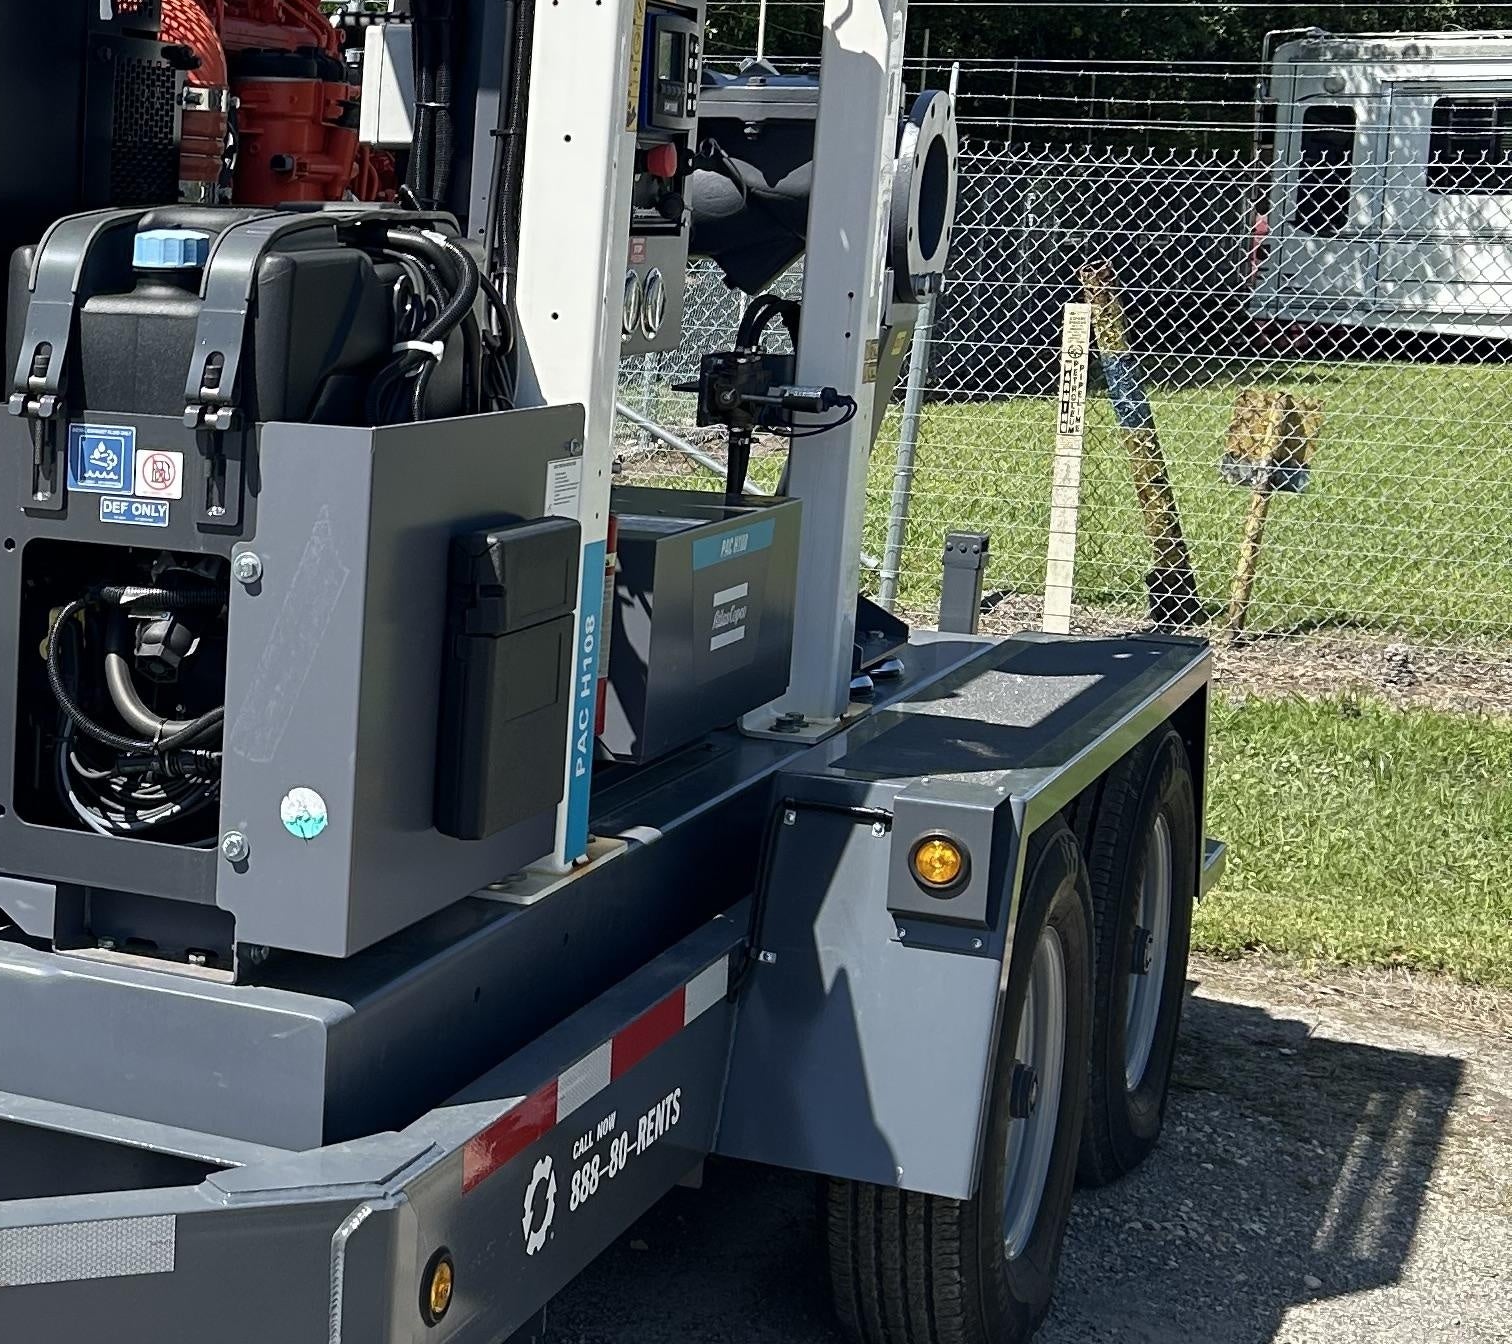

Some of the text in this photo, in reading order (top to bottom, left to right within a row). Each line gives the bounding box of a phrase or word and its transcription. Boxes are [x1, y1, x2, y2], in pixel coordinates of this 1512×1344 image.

[103, 501, 167, 516] DEF ONLY
[575, 615, 596, 778] PAC H108
[569, 1087, 682, 1212] 888-80-RENTS
[573, 1111, 617, 1160] CALL NOW
